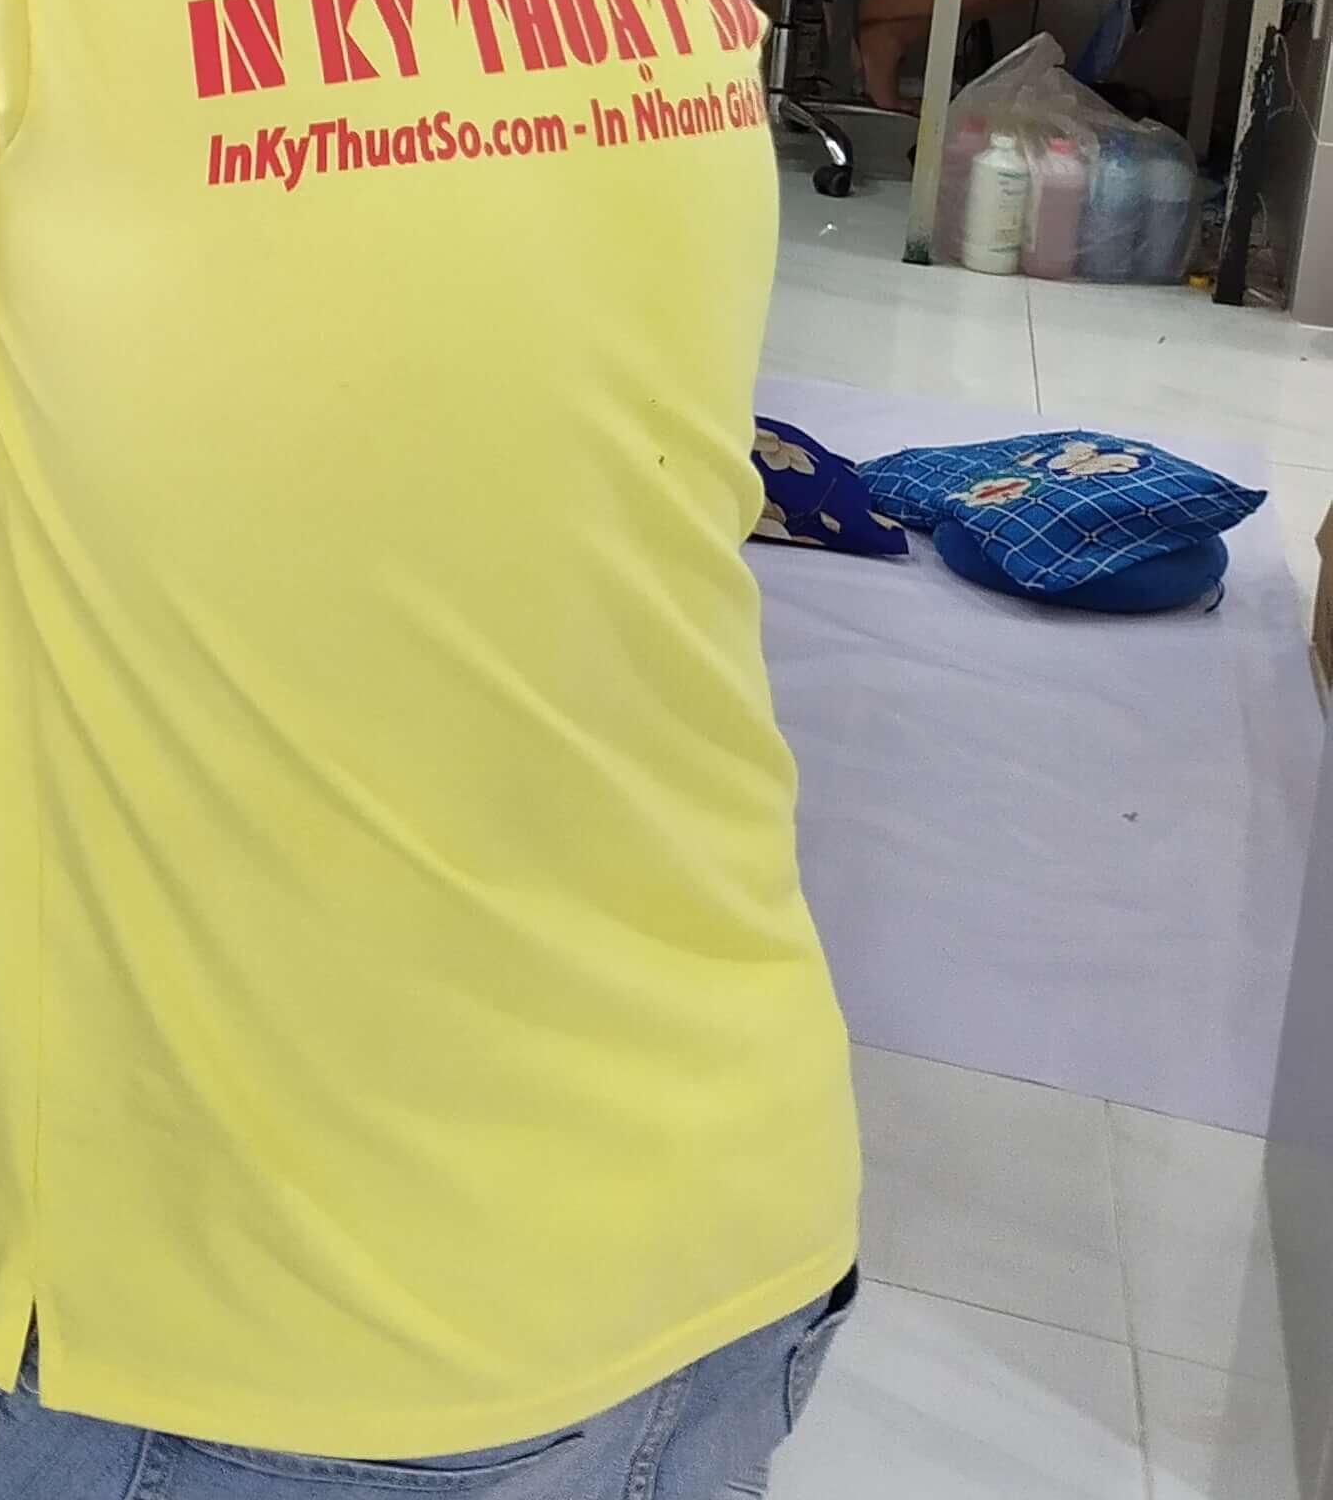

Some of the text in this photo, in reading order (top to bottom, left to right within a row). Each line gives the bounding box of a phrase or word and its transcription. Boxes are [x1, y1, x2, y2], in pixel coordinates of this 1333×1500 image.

[207, 109, 569, 192] InKyThuatSo.com
[590, 97, 629, 147] In
[631, 81, 726, 142] Nhanh
